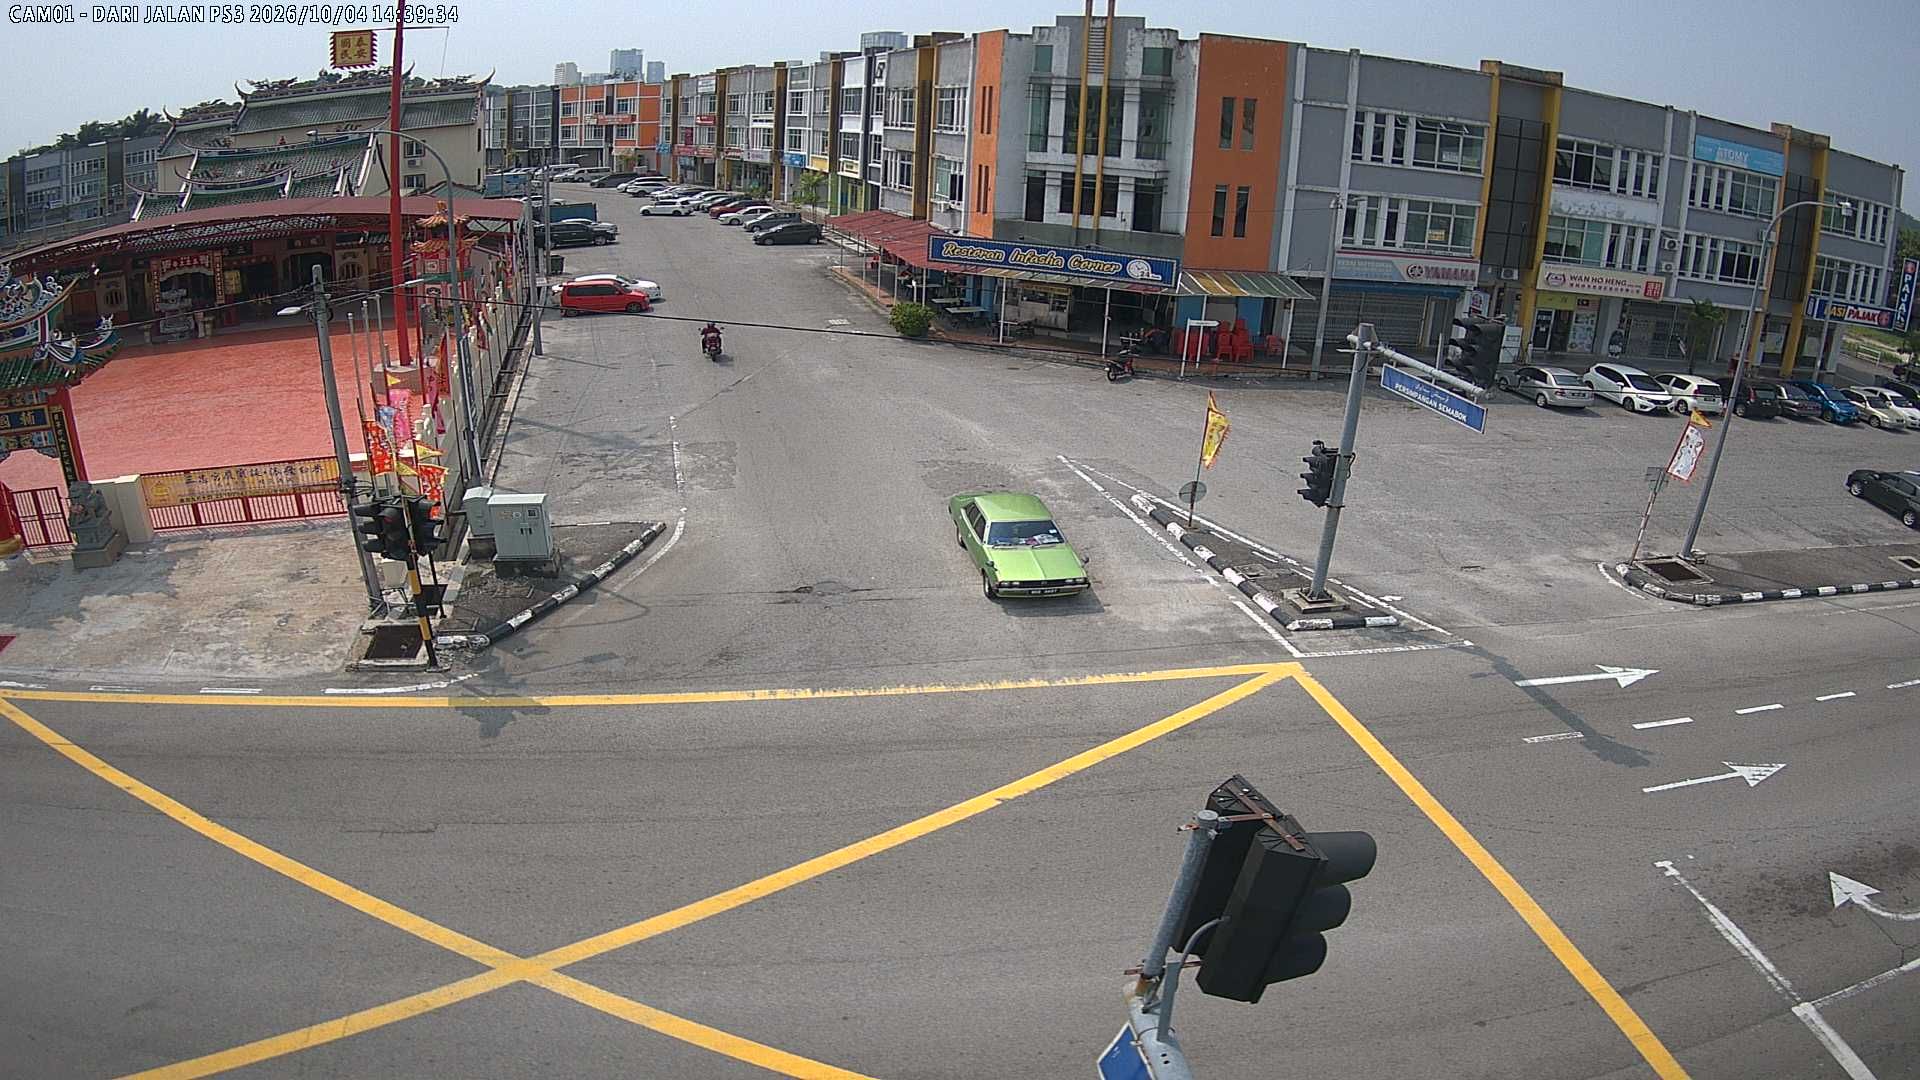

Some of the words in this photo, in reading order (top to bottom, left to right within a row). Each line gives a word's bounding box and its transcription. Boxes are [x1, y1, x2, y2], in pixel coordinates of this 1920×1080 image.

[943, 243, 1003, 262] Restoran
[1009, 248, 1064, 268] Infasha
[1067, 255, 1120, 273] Corner
[1424, 265, 1476, 281] YAMAHA
[1570, 272, 1590, 282] WAN
[1591, 276, 1604, 284] HO
[1604, 277, 1627, 286] HENG
[1897, 273, 1912, 323] PAJAK
[1847, 307, 1878, 323] PAJAK
[1395, 383, 1437, 407] PERSIMPANGAN
[1438, 403, 1466, 421] SEMABOK
